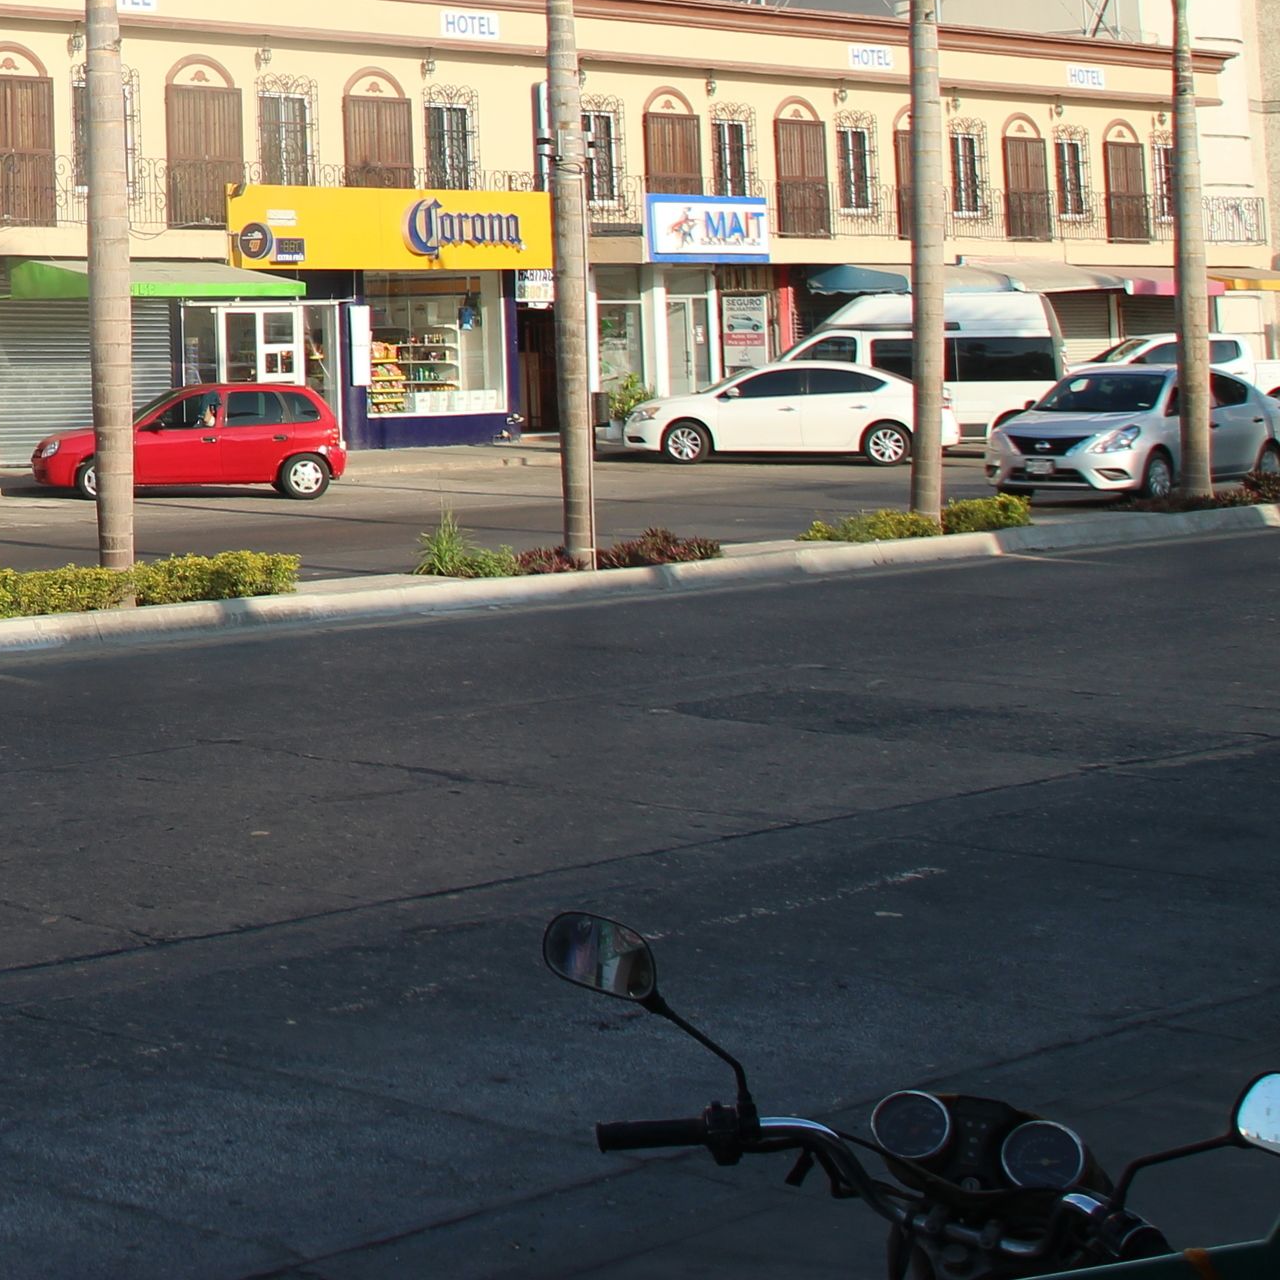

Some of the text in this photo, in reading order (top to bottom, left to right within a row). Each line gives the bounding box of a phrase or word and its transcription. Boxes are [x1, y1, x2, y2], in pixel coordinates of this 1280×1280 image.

[444, 13, 496, 37] HOTEL
[851, 48, 891, 67] HOTEL
[1069, 67, 1103, 87] HOTEL
[404, 198, 522, 255] Corona
[726, 298, 762, 306] SEGURO
